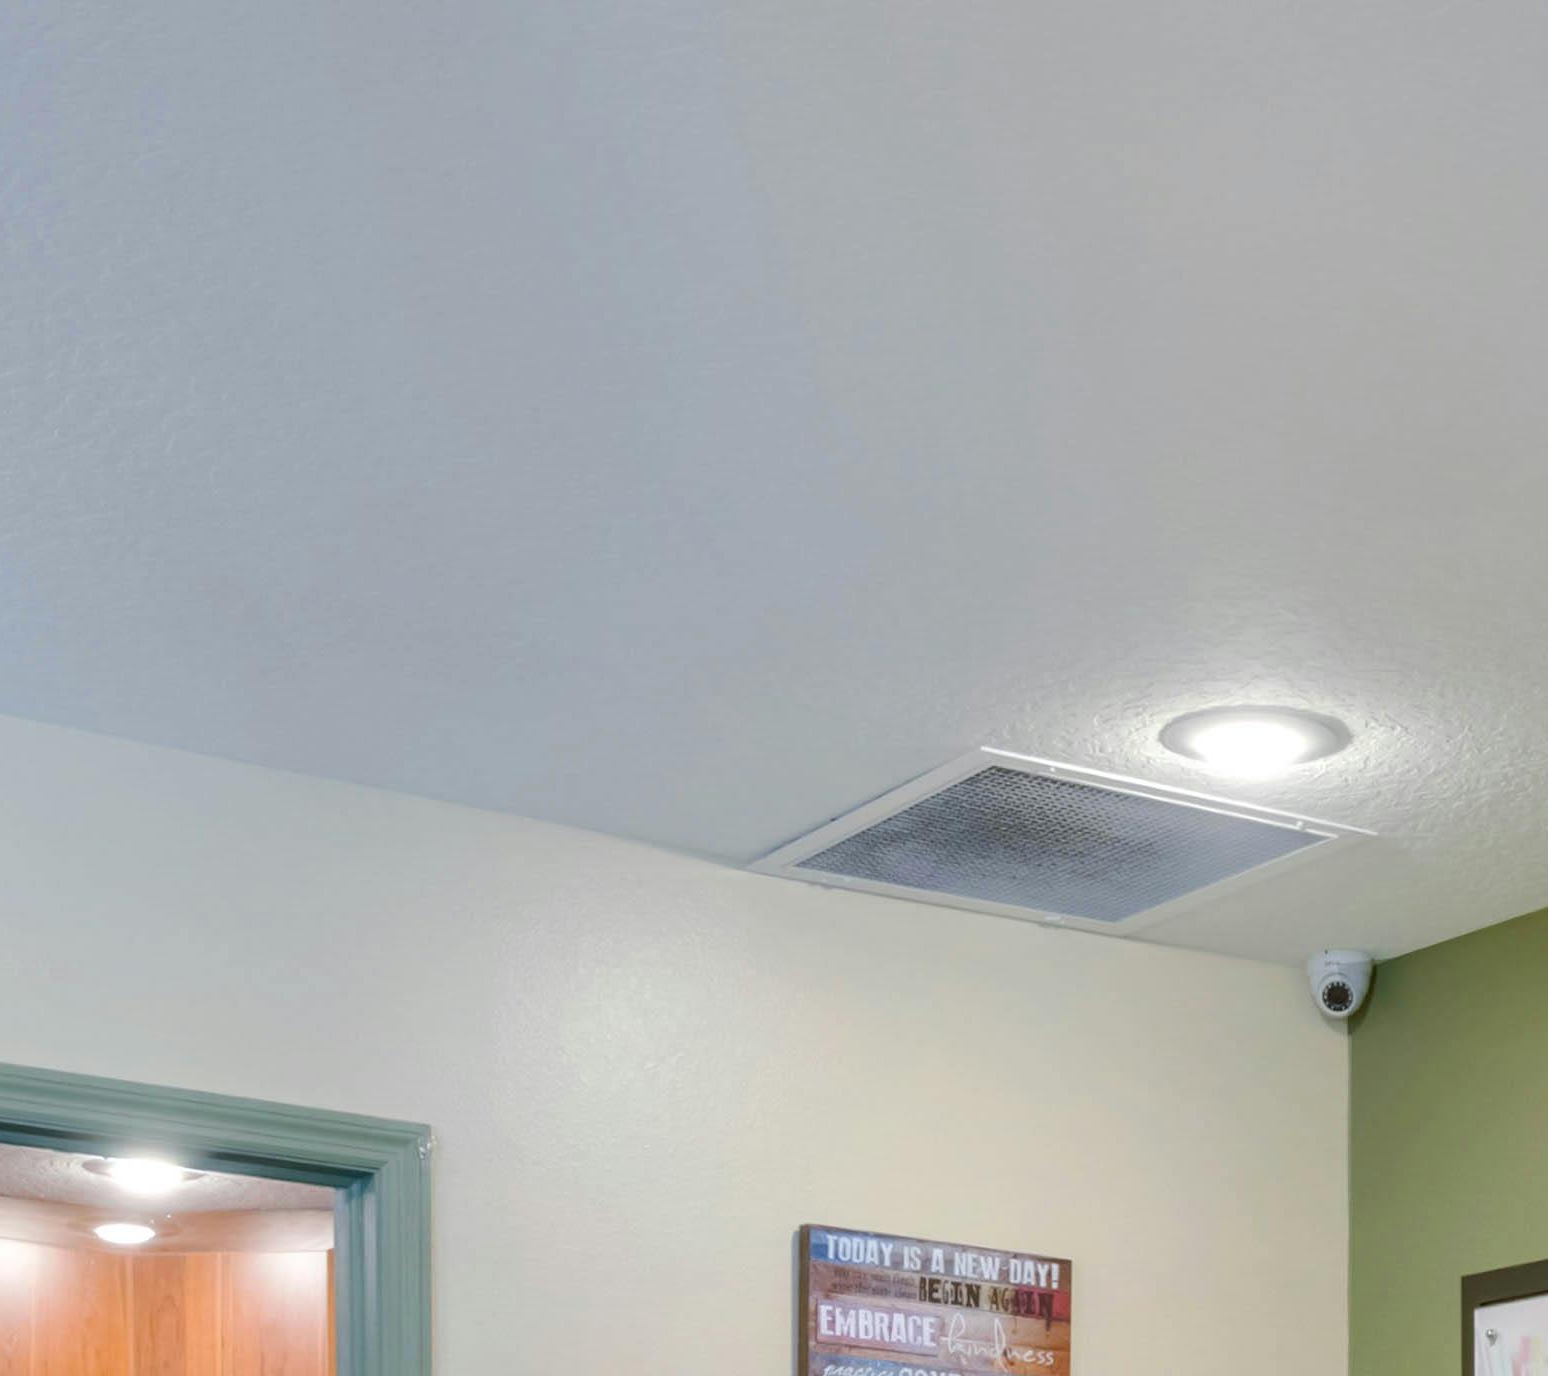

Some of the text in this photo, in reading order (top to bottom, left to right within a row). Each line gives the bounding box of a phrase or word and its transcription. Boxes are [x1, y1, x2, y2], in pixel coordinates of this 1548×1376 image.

[826, 1234, 1060, 1289] TODAY IS A NEW DAY!
[918, 1276, 981, 1308] BEGIN
[989, 1285, 1054, 1319] AGAIN
[819, 1304, 1054, 1372] EMBRACE kindness
